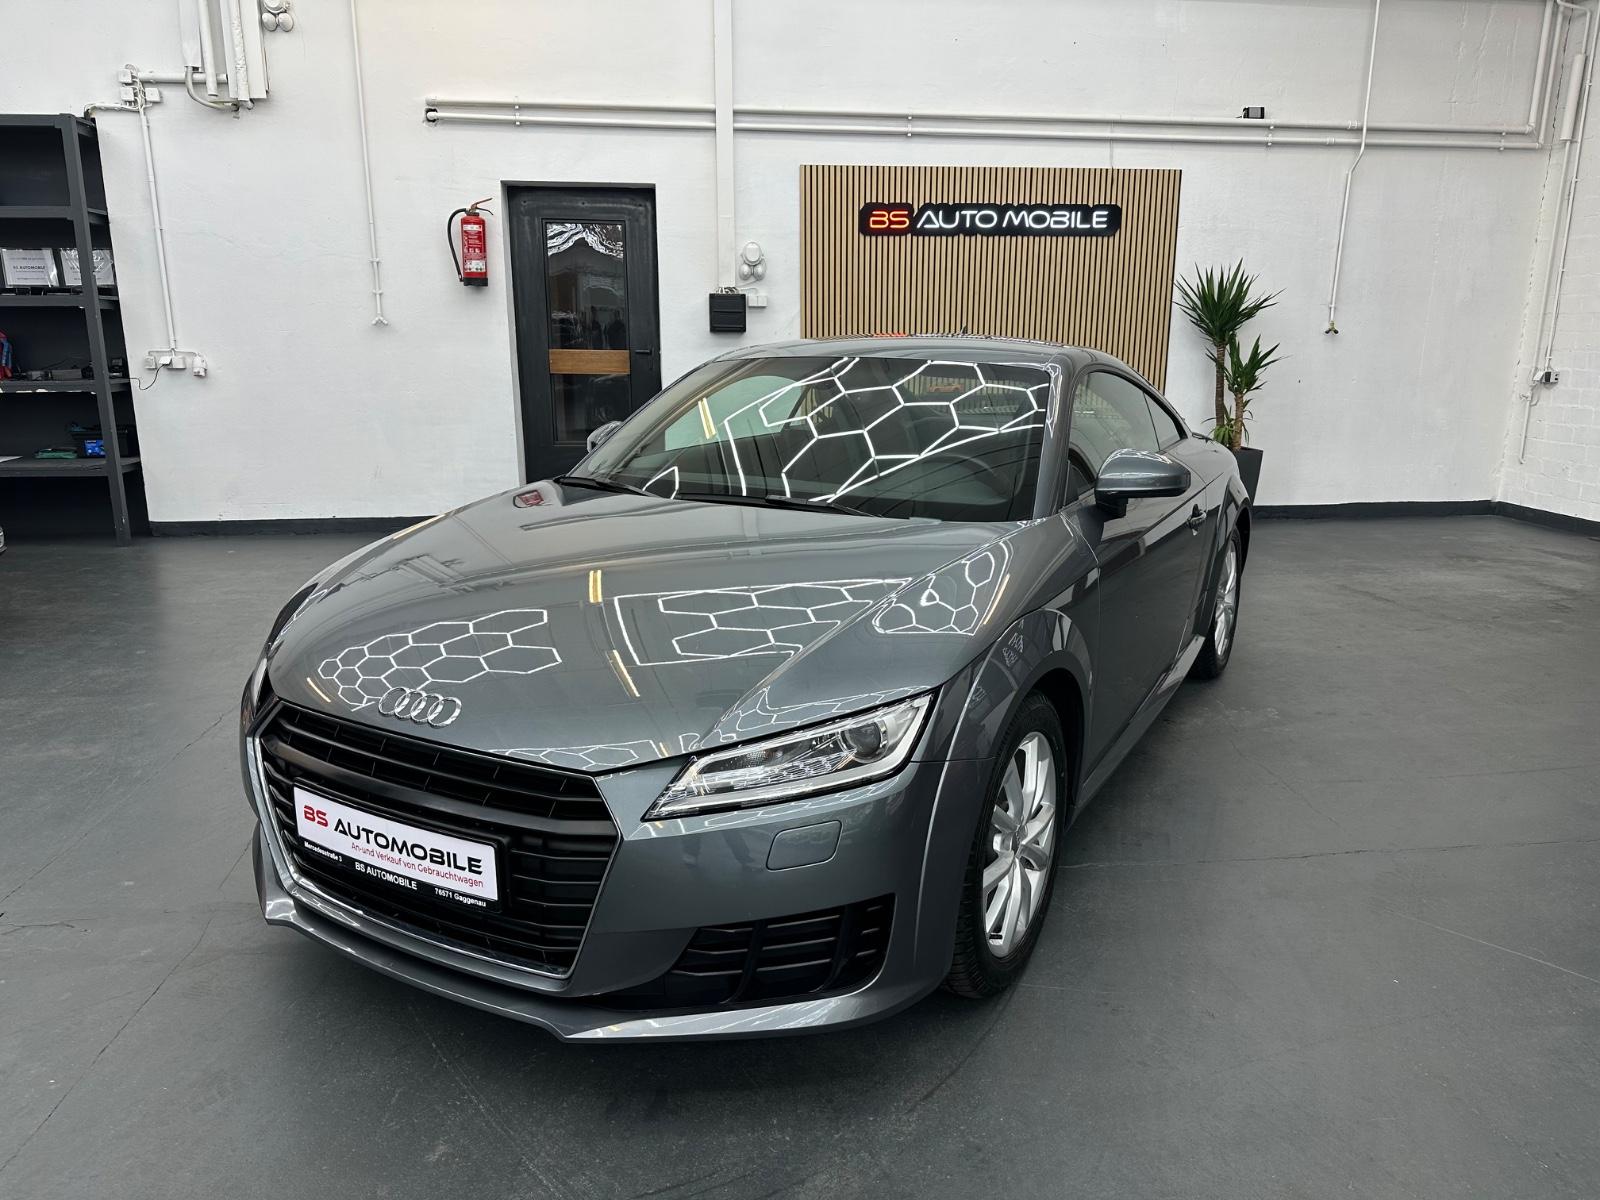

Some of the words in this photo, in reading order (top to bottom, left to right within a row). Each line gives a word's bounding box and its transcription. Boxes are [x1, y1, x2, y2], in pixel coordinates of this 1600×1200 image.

[869, 210, 910, 229] BS
[917, 210, 997, 229] AUTO
[1002, 210, 1108, 229] MOBILE
[303, 804, 329, 828] BS
[334, 818, 483, 876] AUTOMOBILE
[354, 861, 366, 872] BS
[366, 866, 418, 890] AUTOMOBILE
[375, 850, 402, 866] Verkauf
[402, 860, 416, 870] von
[417, 863, 484, 888] Gebrauchtwagen
[453, 893, 487, 907] Gaggenau
